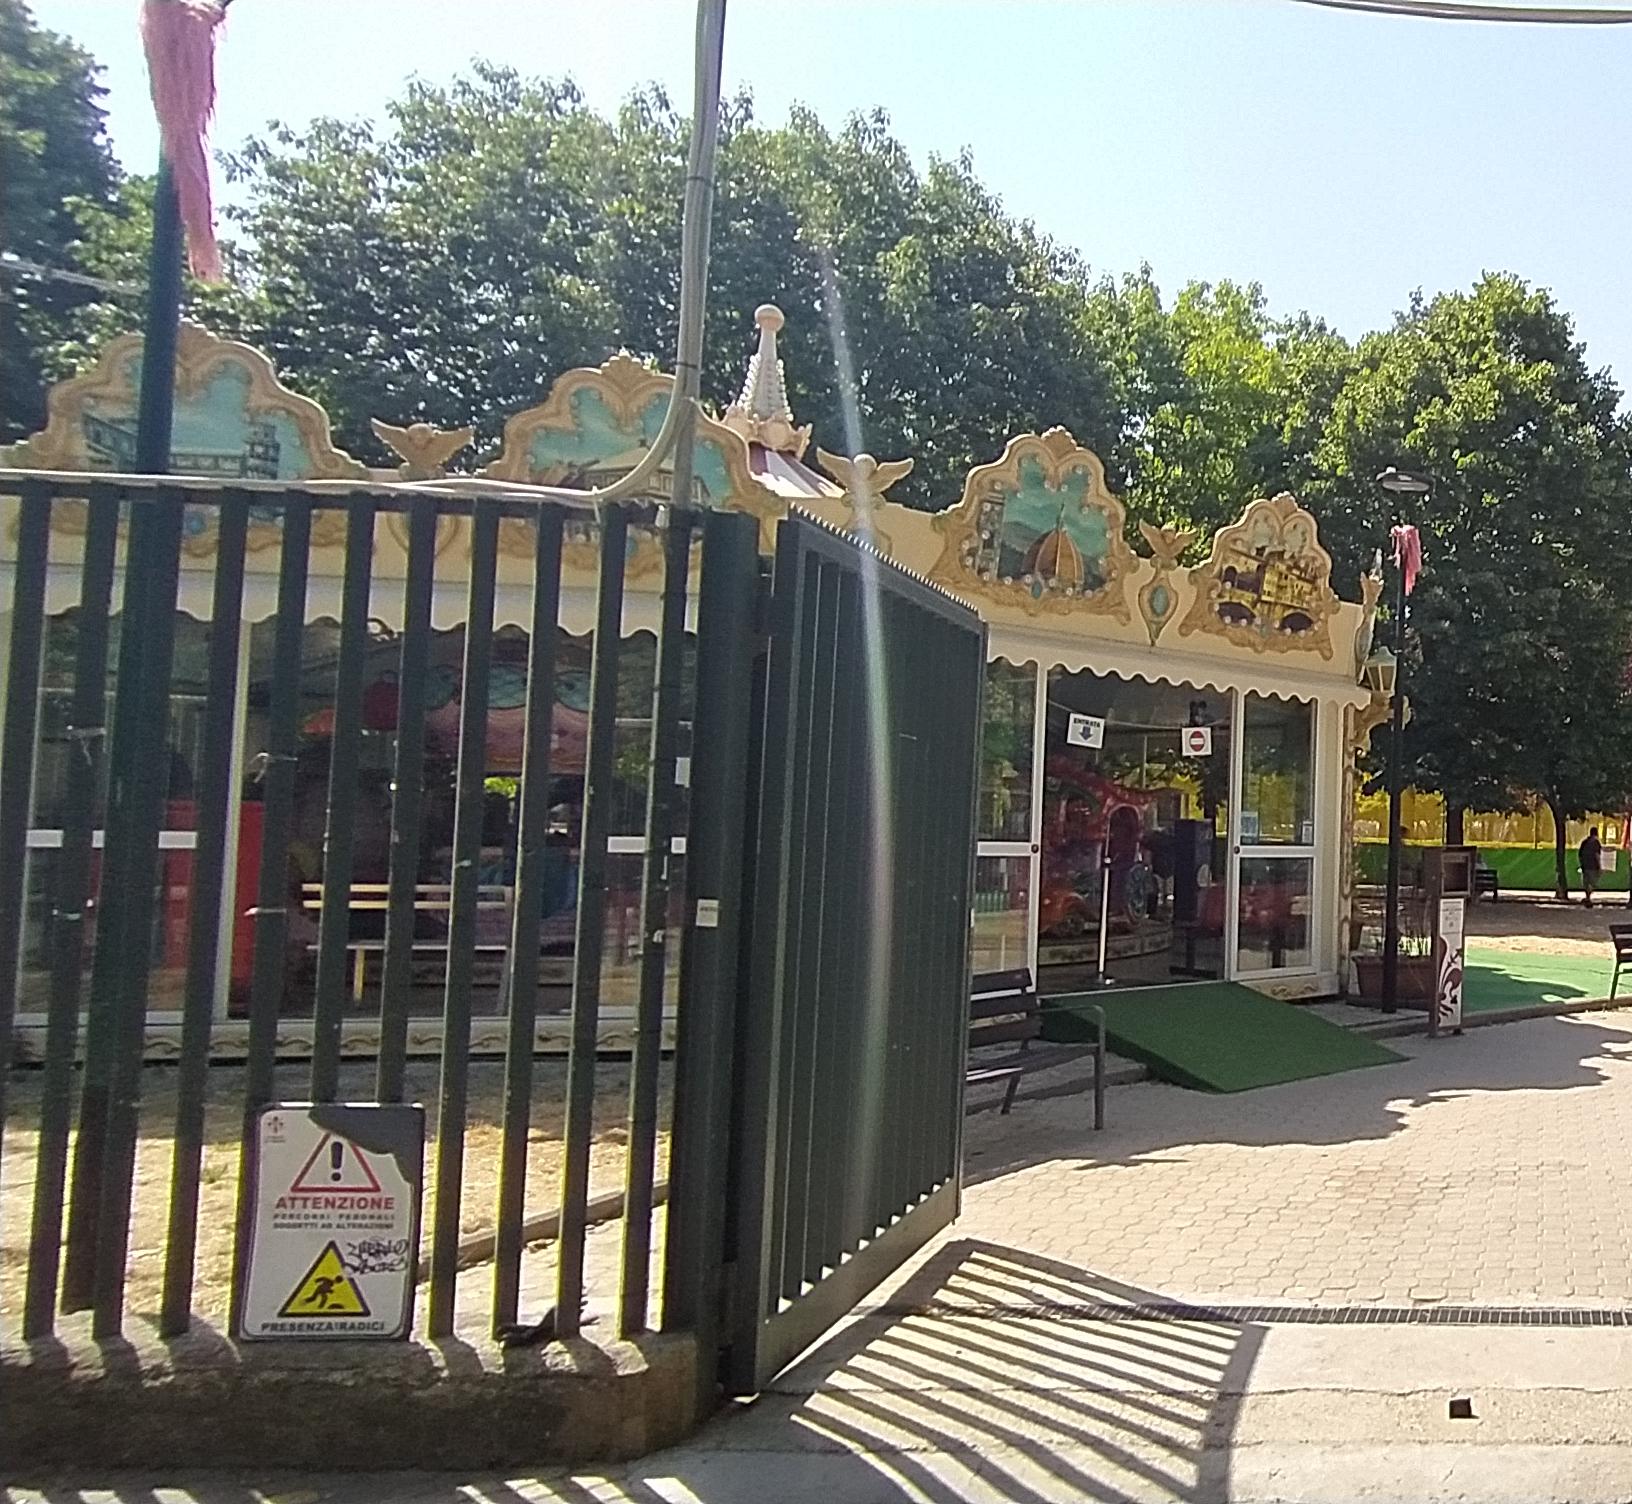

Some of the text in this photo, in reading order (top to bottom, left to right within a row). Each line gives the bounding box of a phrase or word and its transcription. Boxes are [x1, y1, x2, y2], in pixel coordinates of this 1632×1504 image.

[275, 1196, 395, 1210] ATTENZIONE
[261, 1321, 385, 1332] PRESENZA RADICI
